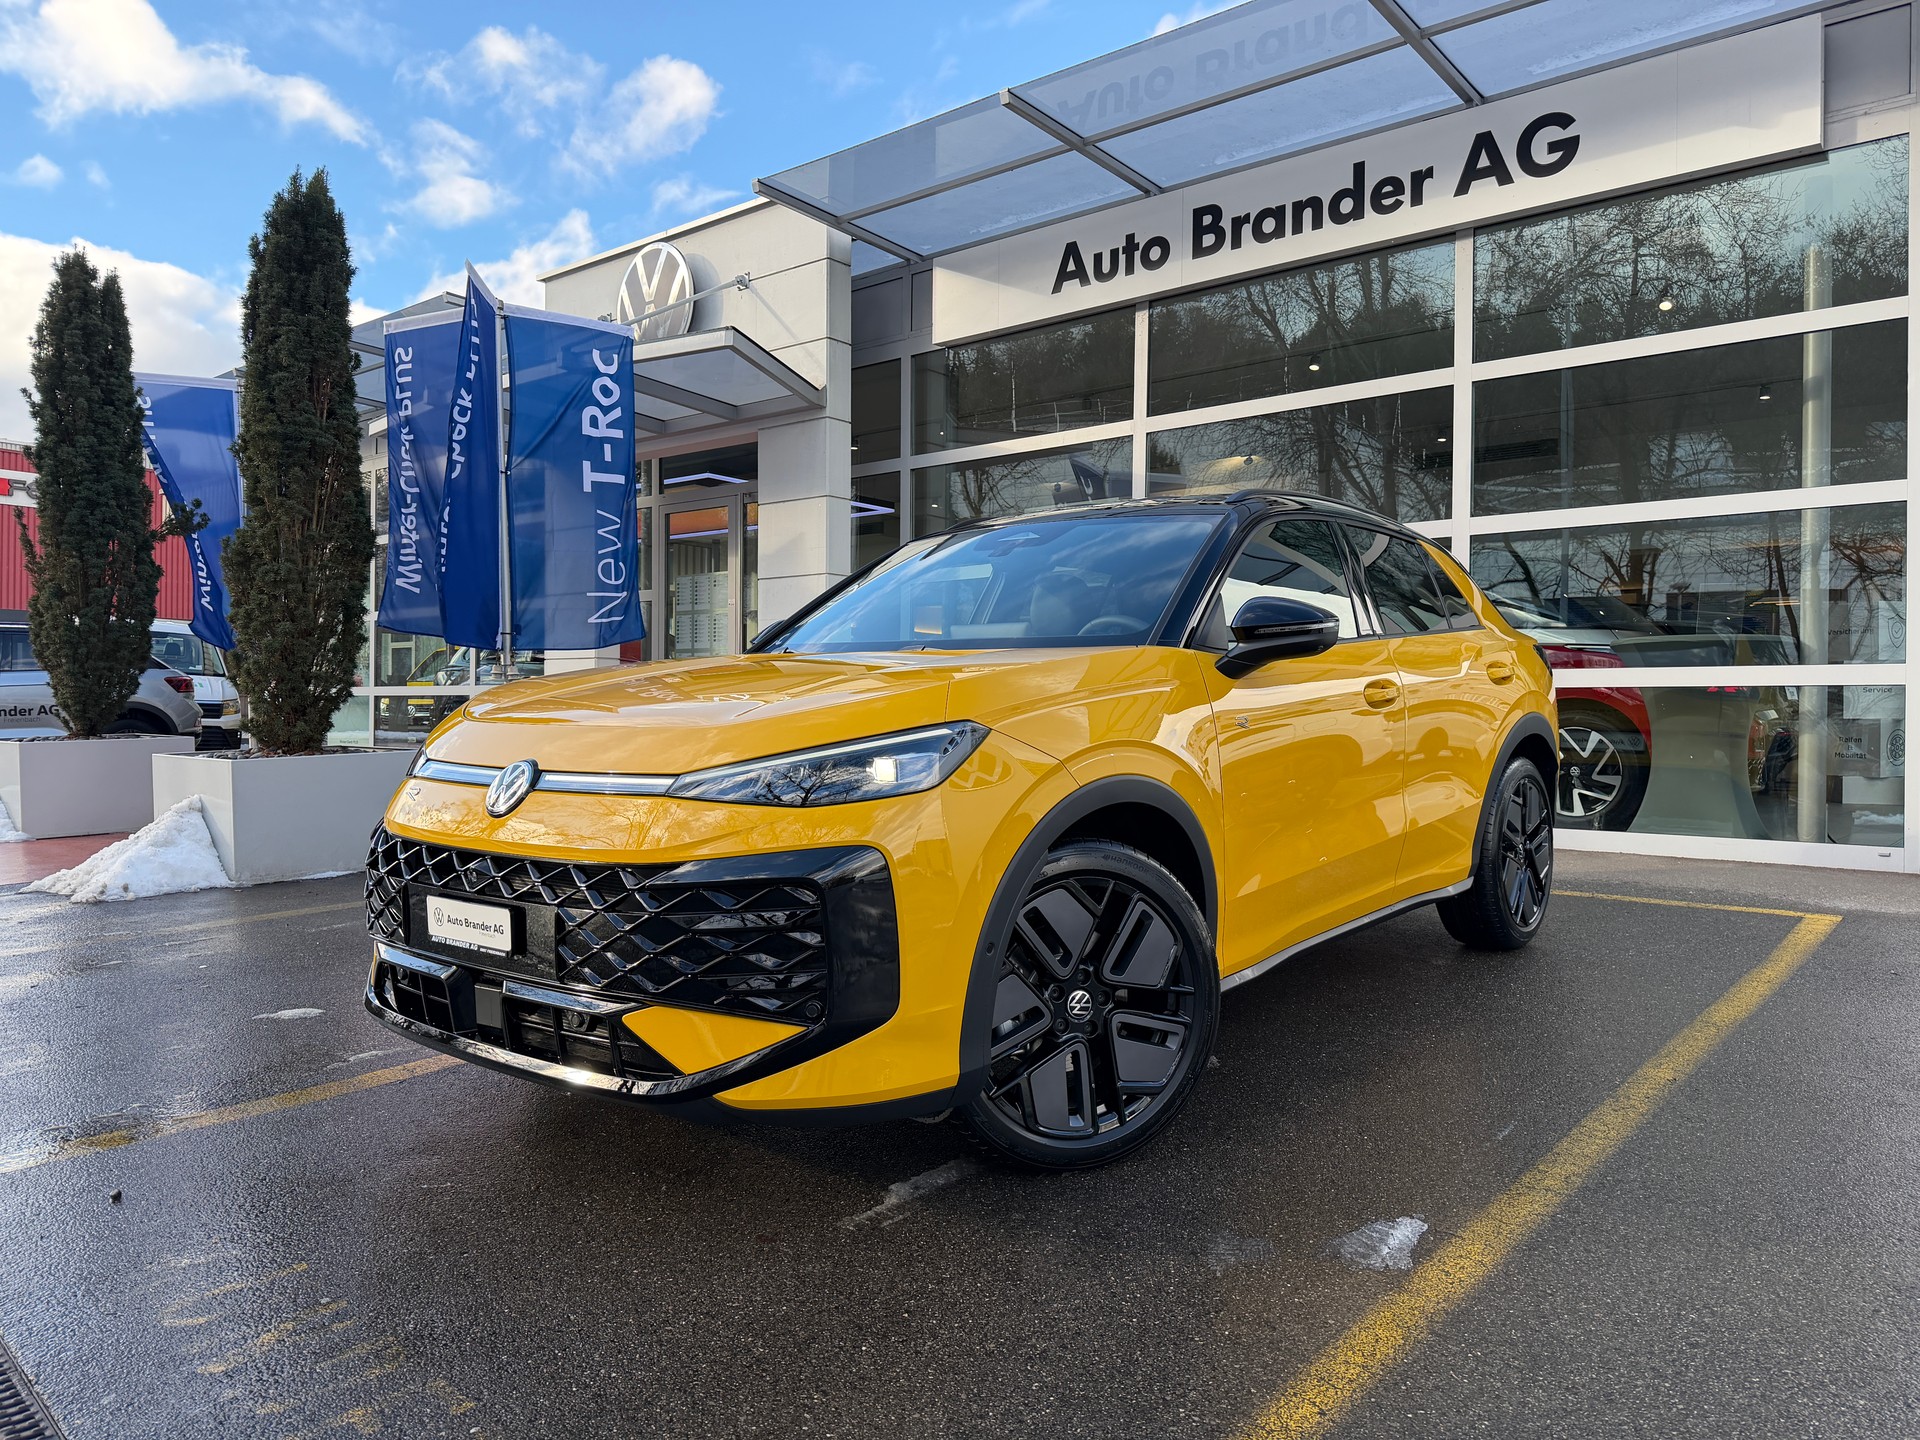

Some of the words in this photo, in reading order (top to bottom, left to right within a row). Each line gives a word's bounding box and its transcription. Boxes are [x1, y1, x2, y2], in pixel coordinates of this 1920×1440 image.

[1051, 233, 1171, 295] Auto
[1191, 161, 1434, 261] Brander
[1453, 111, 1581, 198] AG
[582, 348, 626, 493] T-Roc
[586, 509, 628, 624] New
[37, 704, 60, 716] AG
[431, 935, 446, 944] AUTO
[445, 938, 470, 949] BRANDER
[447, 914, 464, 927] Auto
[464, 918, 492, 933] Brander
[493, 923, 505, 935] AG
